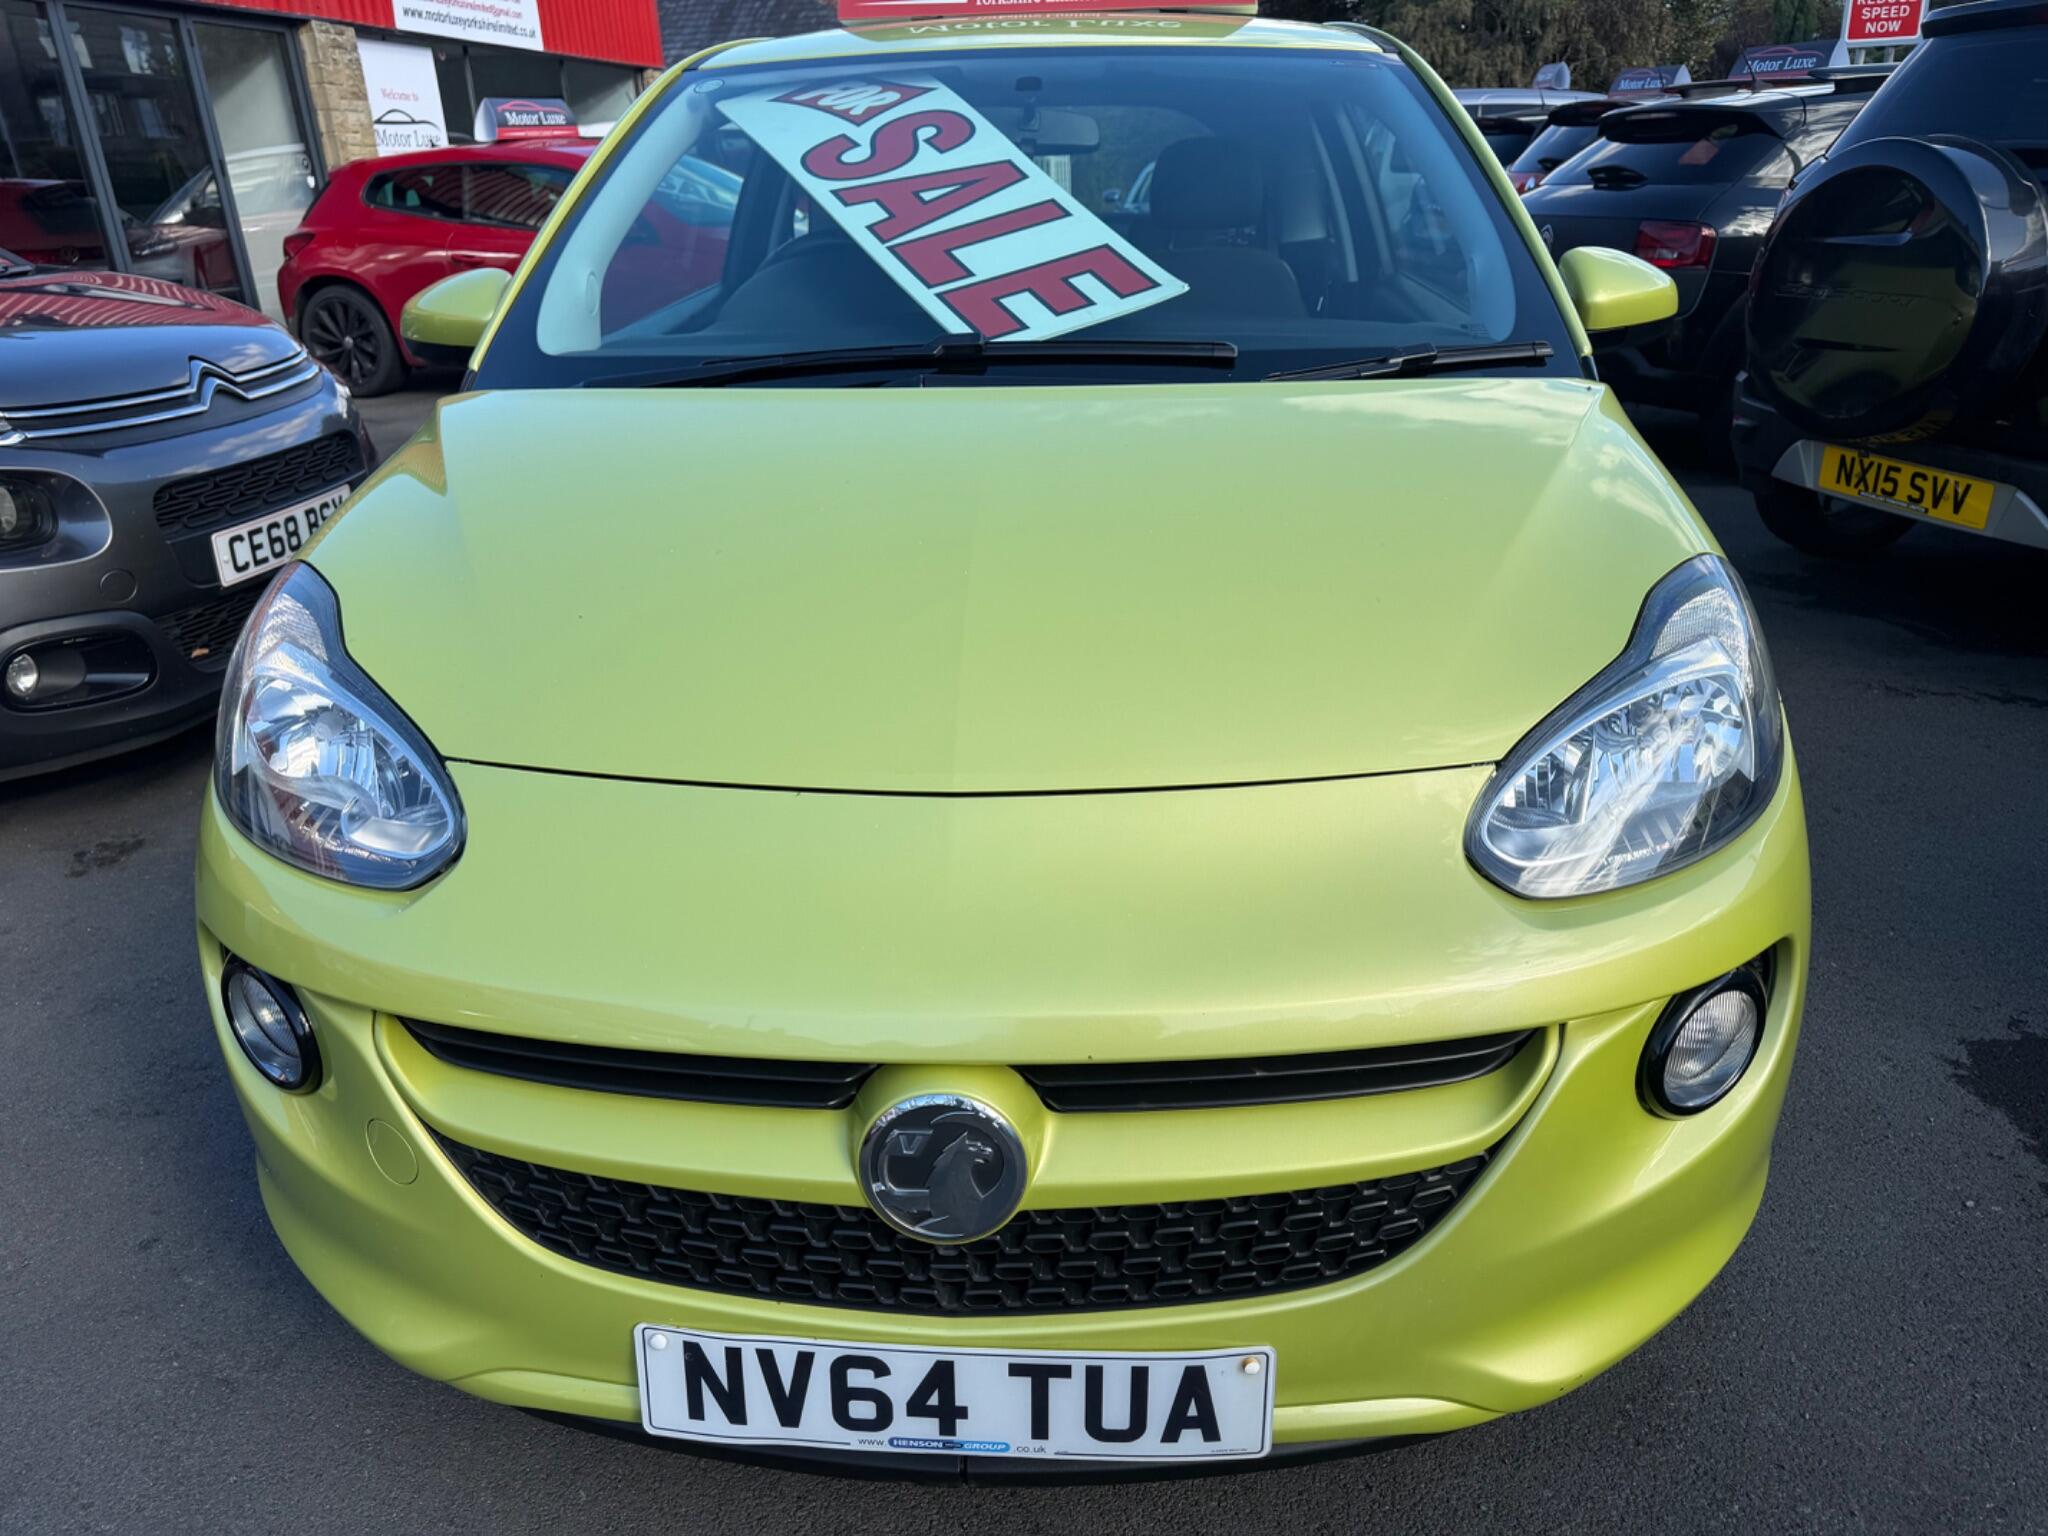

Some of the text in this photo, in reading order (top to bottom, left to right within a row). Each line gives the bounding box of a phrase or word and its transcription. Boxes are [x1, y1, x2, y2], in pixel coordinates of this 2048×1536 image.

[1861, 5, 1910, 20] SPEED
[1865, 20, 1901, 34] NOW
[1743, 56, 1817, 74] Motor Luxe
[504, 111, 567, 126] Motor Luxe
[376, 129, 412, 147] Motor
[791, 80, 1163, 340] FOR SALE
[1835, 454, 1902, 497] NX15
[1906, 471, 1972, 515] SVV
[228, 515, 302, 574] CE68
[682, 1340, 1222, 1444] NV64 TUA
[893, 1438, 944, 1449] HENSON
[962, 1441, 1007, 1451] GROUP
